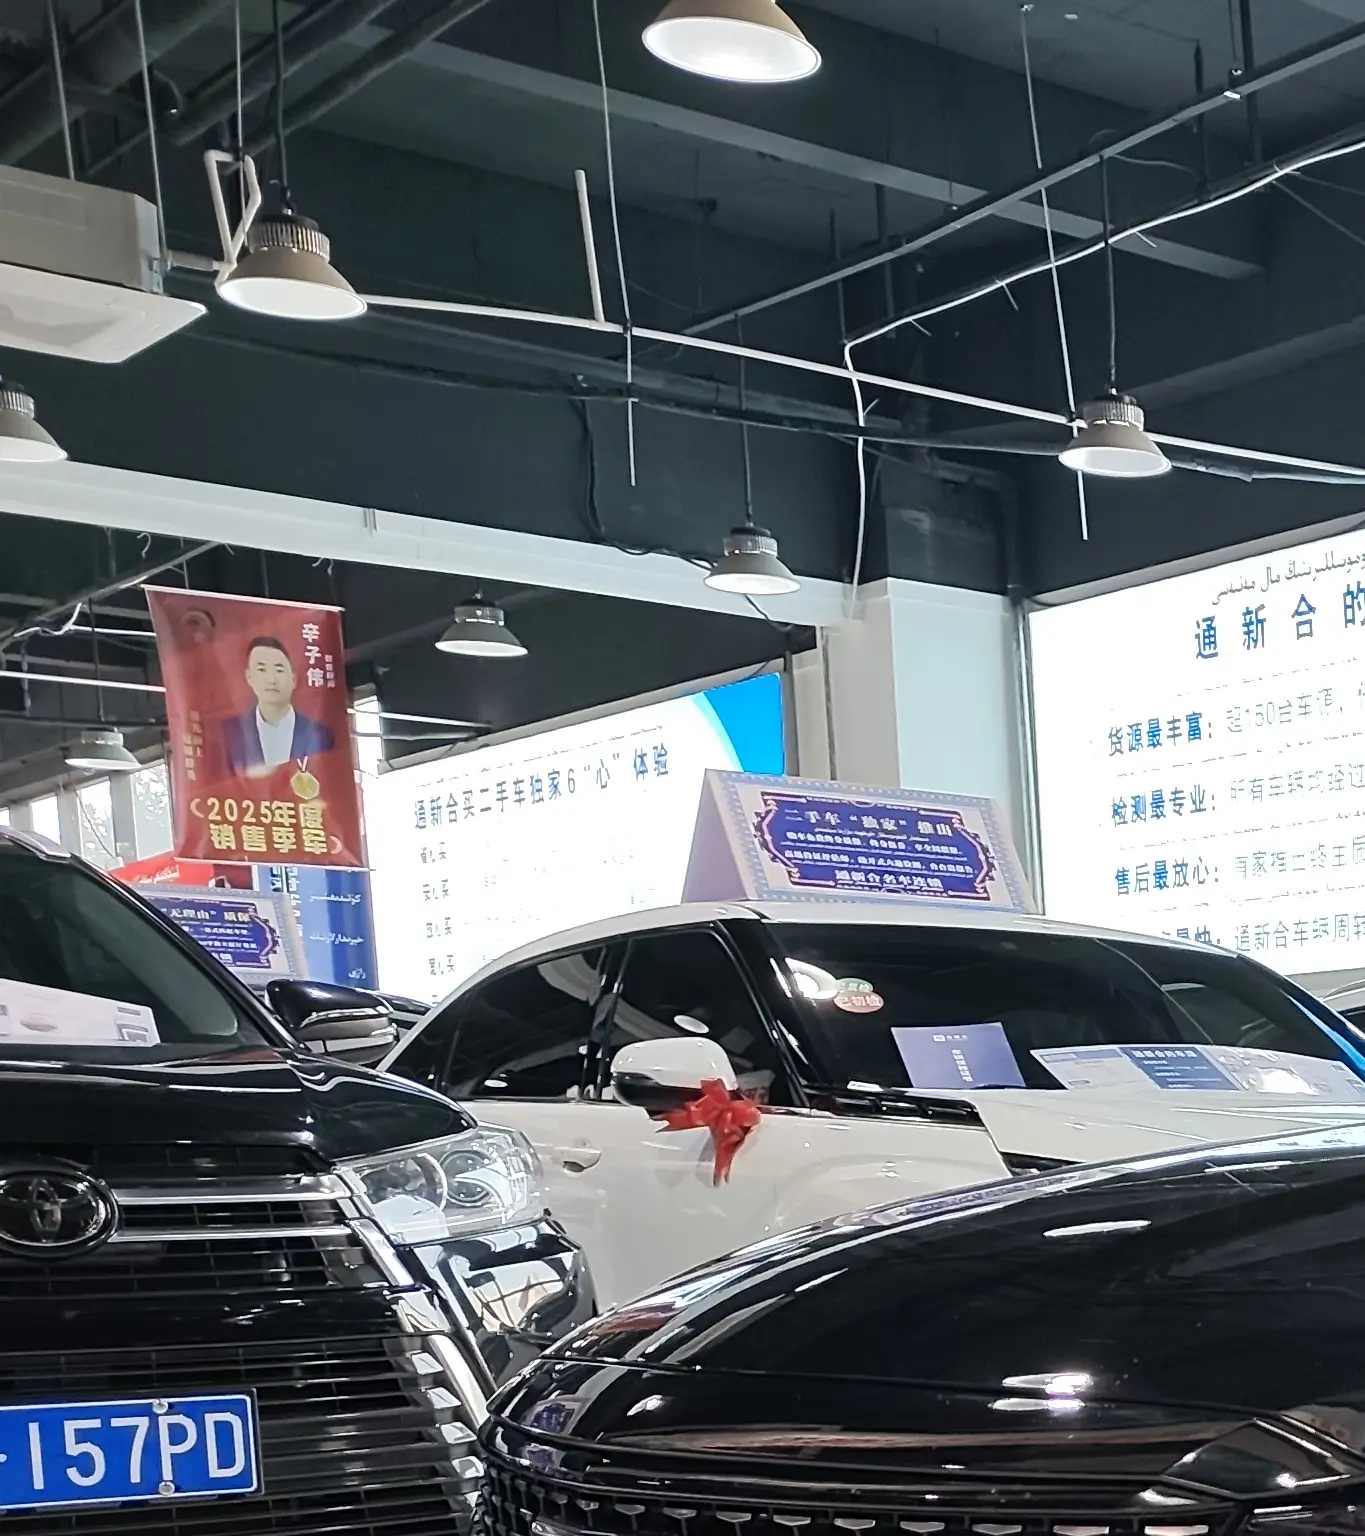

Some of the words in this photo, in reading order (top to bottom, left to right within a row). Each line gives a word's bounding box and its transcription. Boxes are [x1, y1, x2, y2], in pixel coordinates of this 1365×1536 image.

[301, 622, 324, 688] 辛子伟
[206, 797, 323, 830] 2025年度
